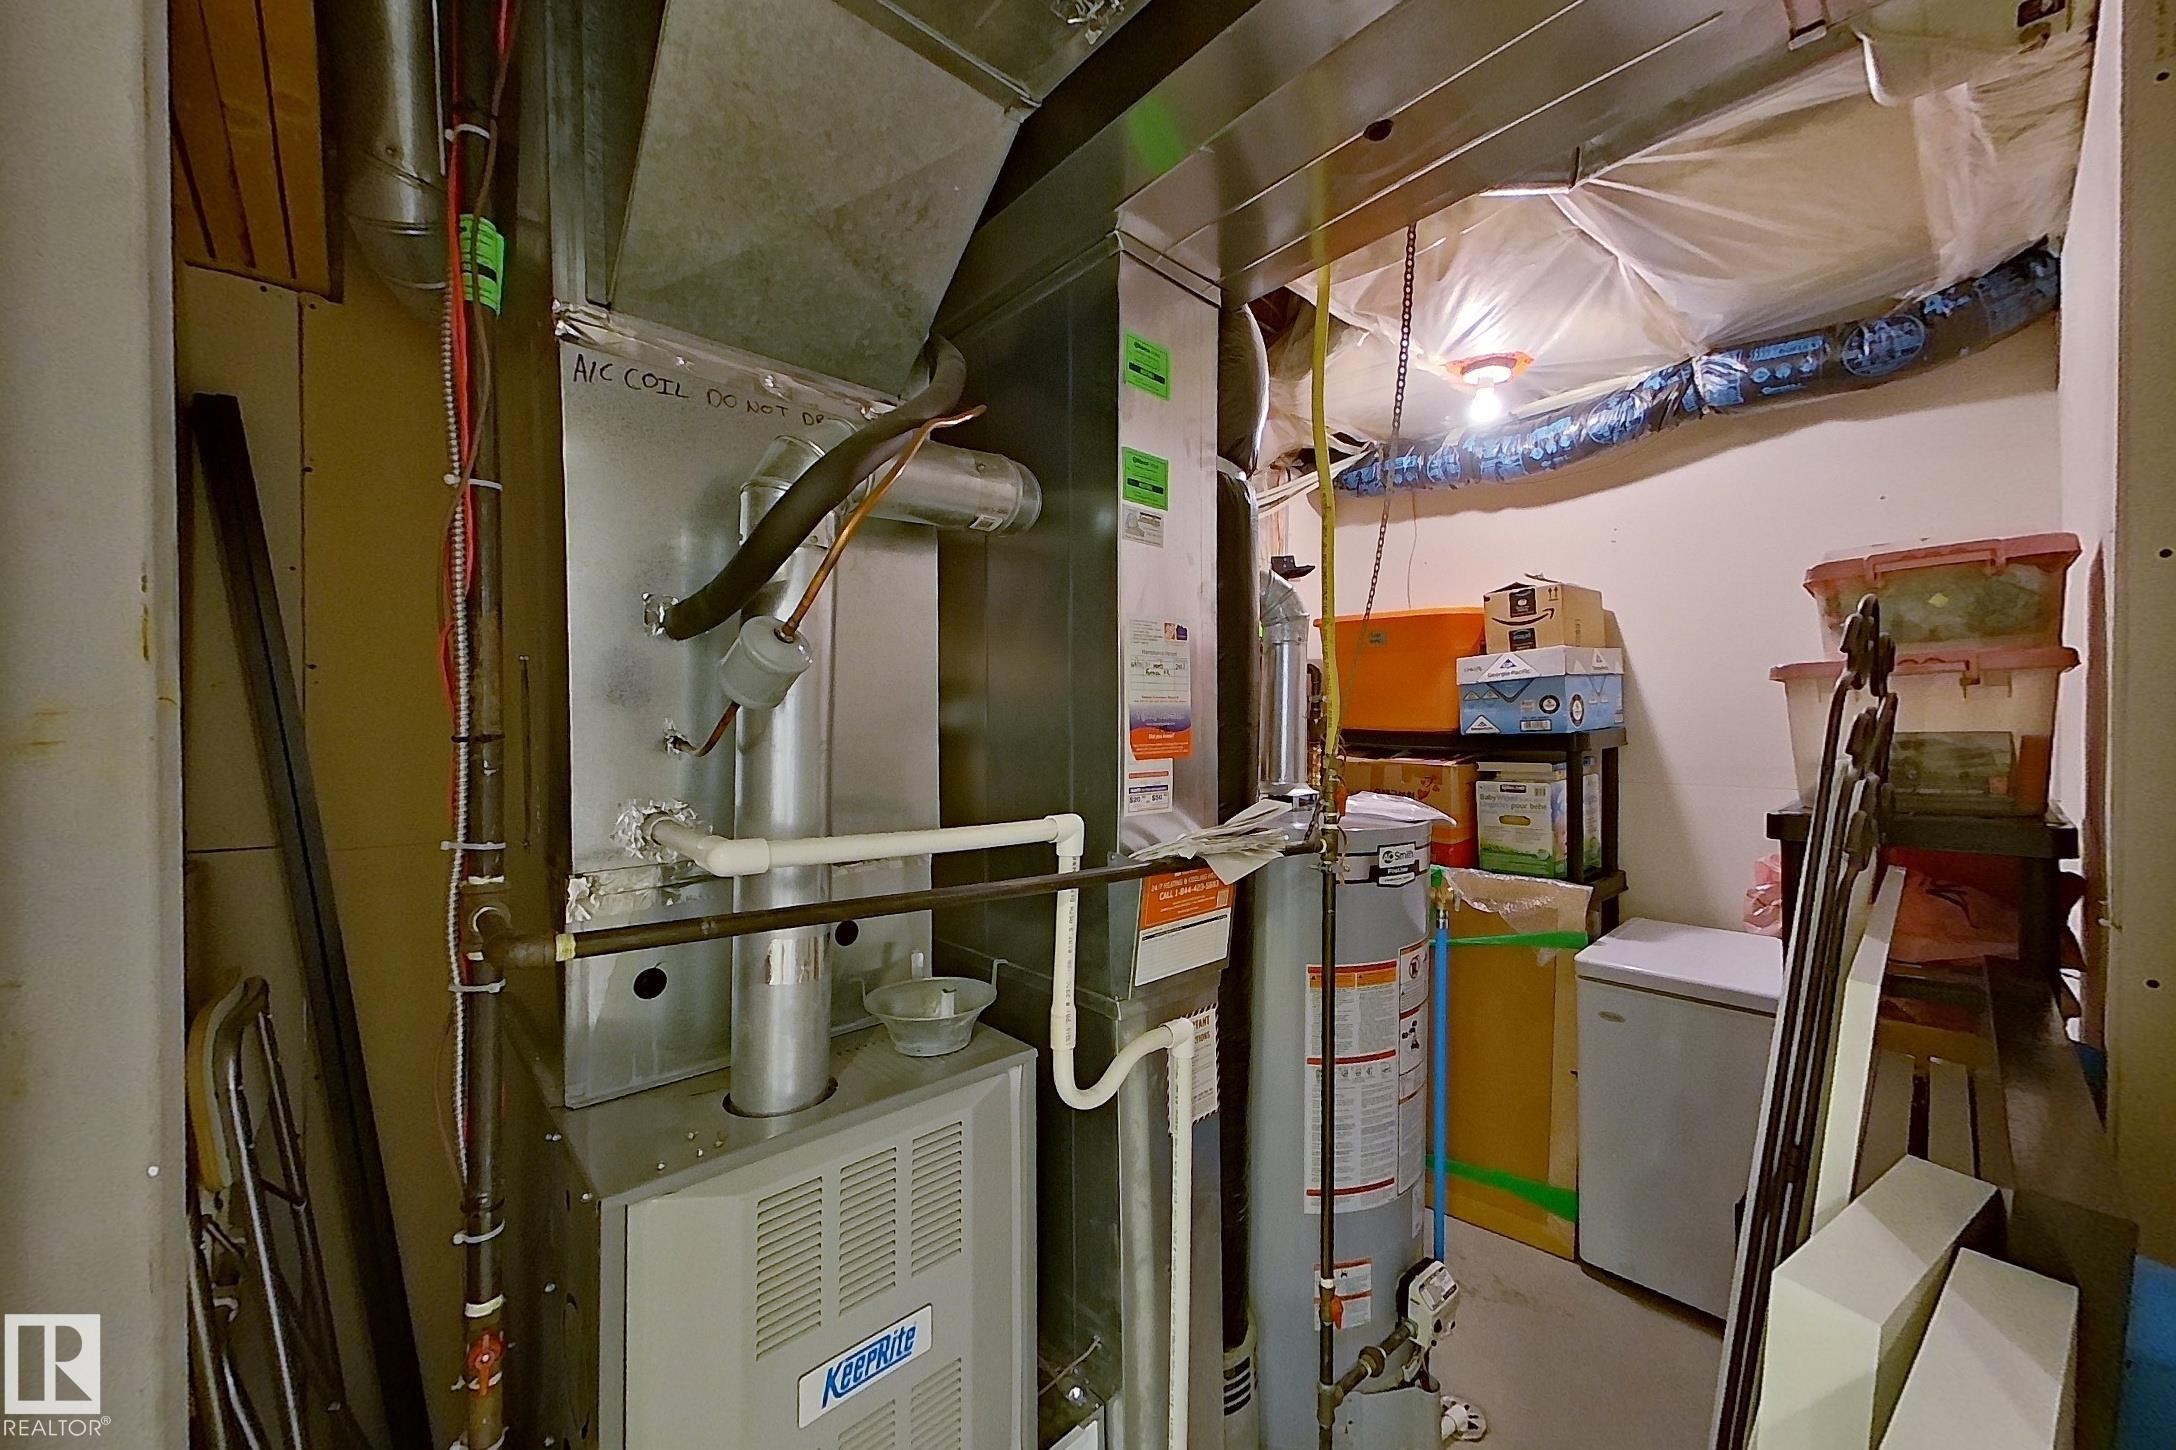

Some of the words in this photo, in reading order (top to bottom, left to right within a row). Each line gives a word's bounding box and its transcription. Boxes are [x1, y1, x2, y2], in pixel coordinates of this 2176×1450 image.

[573, 353, 613, 384] A/C
[624, 367, 689, 399] COIL
[707, 388, 738, 410] DO
[746, 400, 788, 417] NOT
